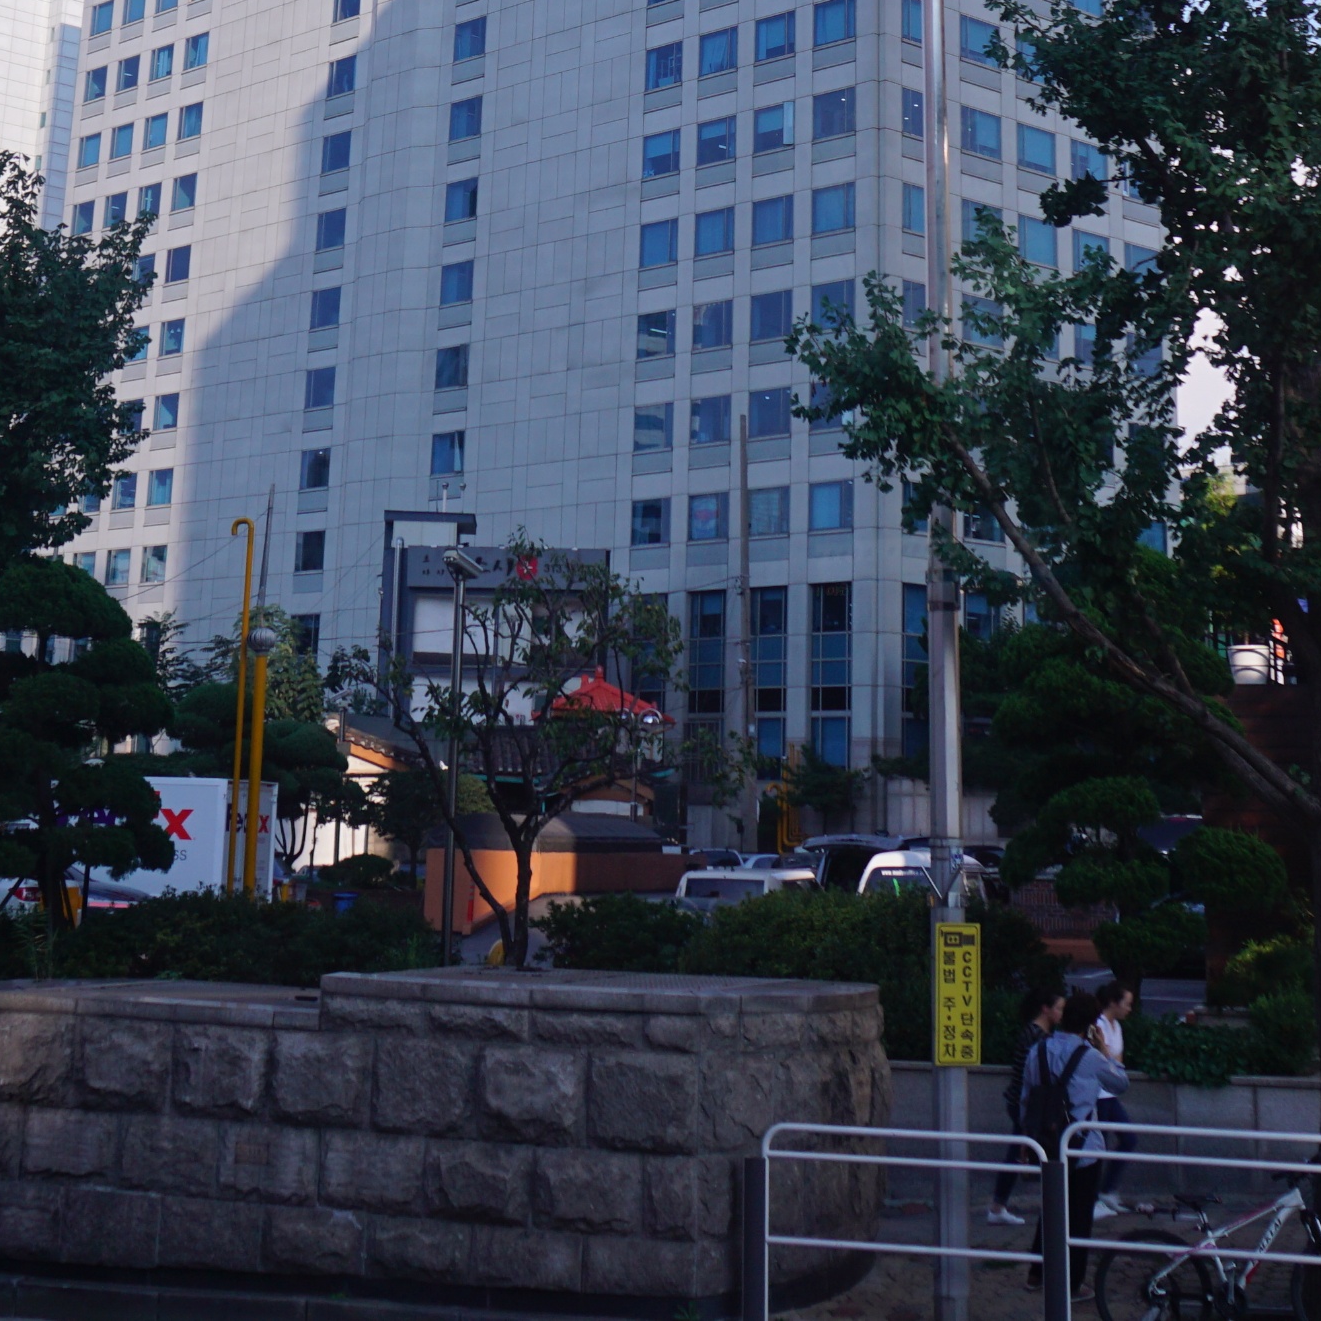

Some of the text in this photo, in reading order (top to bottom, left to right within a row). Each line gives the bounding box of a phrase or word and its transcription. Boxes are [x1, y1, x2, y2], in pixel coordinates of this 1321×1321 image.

[943, 950, 956, 984] 불법
[960, 951, 975, 1060] CCTV 단속중
